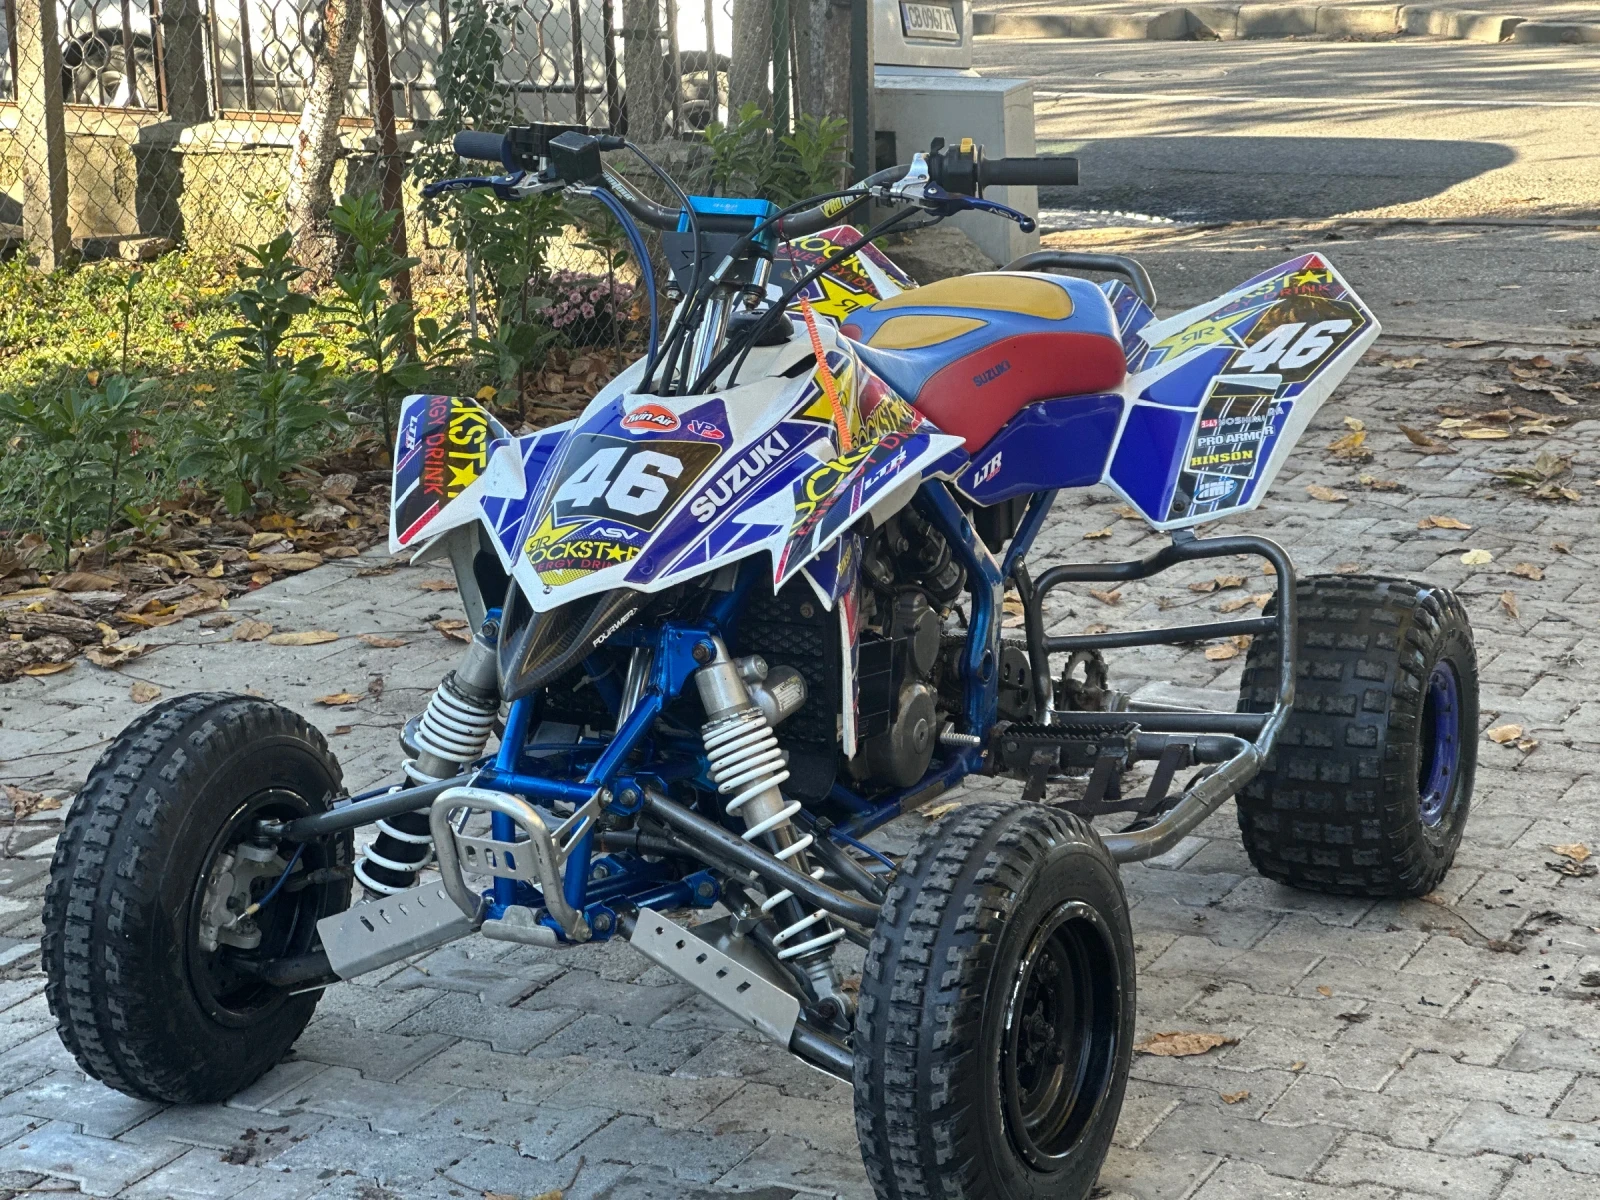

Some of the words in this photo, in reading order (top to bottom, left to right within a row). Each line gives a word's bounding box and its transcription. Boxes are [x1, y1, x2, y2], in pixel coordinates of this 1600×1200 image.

[1263, 284, 1331, 301] DRINK
[1231, 318, 1353, 373] 46
[972, 359, 1012, 388] SUZUKI
[626, 410, 654, 424] Twin
[651, 413, 677, 426] Air
[1197, 434, 1224, 448] PRO
[1225, 425, 1275, 444] ARMOR
[423, 433, 446, 496] DRINK
[973, 450, 1003, 490] LTR
[1190, 449, 1254, 467] HINSON
[570, 446, 685, 517] 46
[689, 429, 790, 523] SUZUKI
[589, 526, 640, 540] ASV
